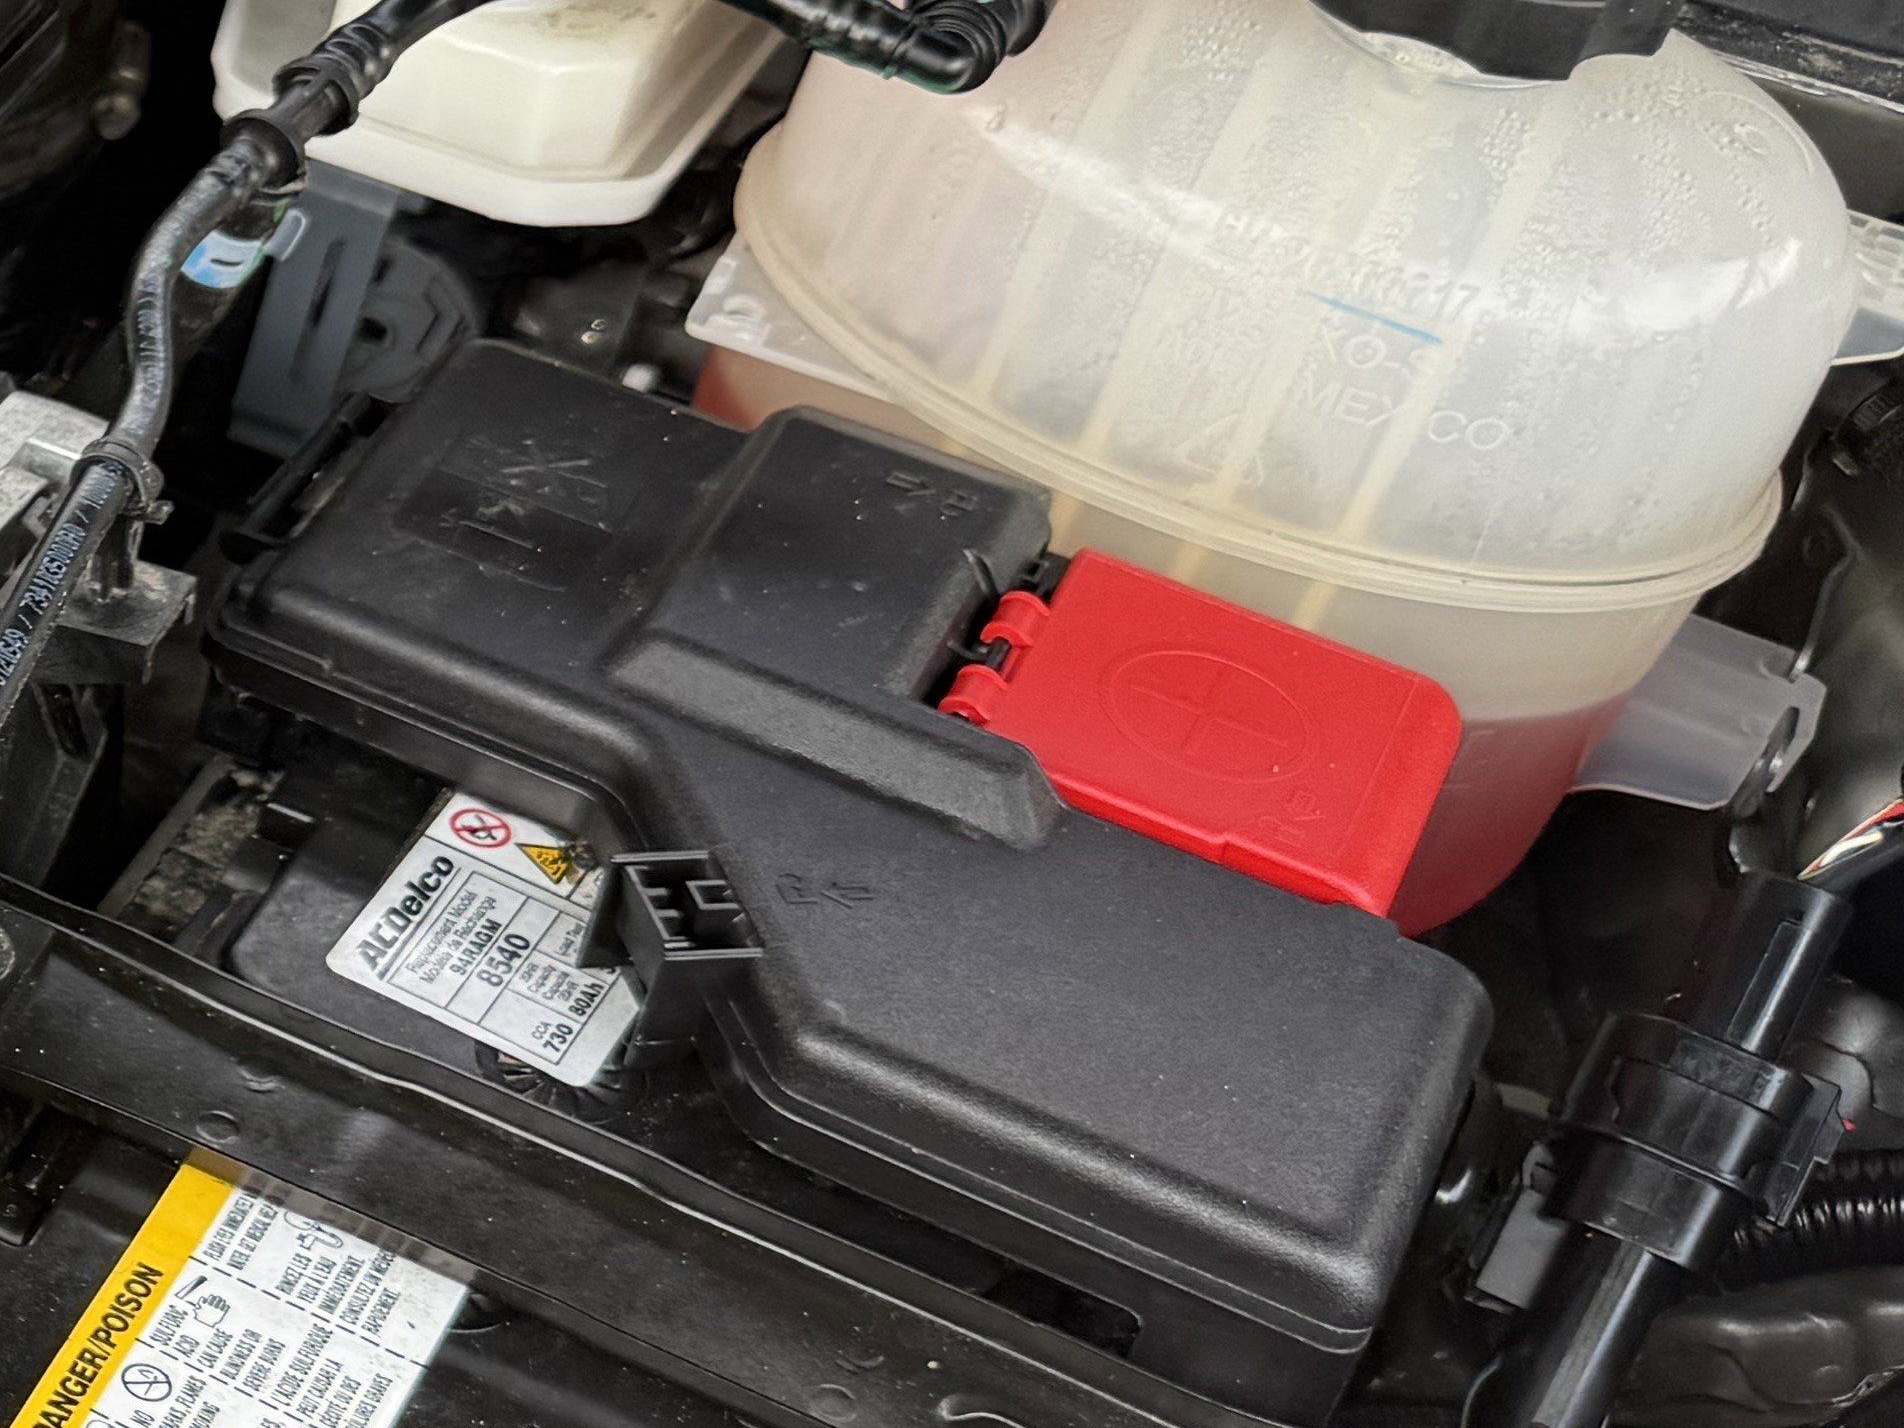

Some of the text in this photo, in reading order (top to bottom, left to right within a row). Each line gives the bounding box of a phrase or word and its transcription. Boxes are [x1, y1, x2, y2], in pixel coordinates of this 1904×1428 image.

[1299, 377, 1510, 450] MEXCO
[353, 855, 455, 971] ACDelco
[447, 888, 477, 919] Model
[448, 916, 502, 977] 94RAGM
[475, 930, 532, 989] 8540
[530, 1020, 551, 1040] CCA
[542, 1021, 574, 1054] 730
[289, 1252, 312, 1270] LES
[148, 1303, 189, 1347] SULFURIC
[171, 1332, 200, 1358] ACID
[196, 1327, 233, 1369] CAN CAUSE
[174, 1374, 207, 1409] FLAMES
[129, 1408, 156, 1428] NO
